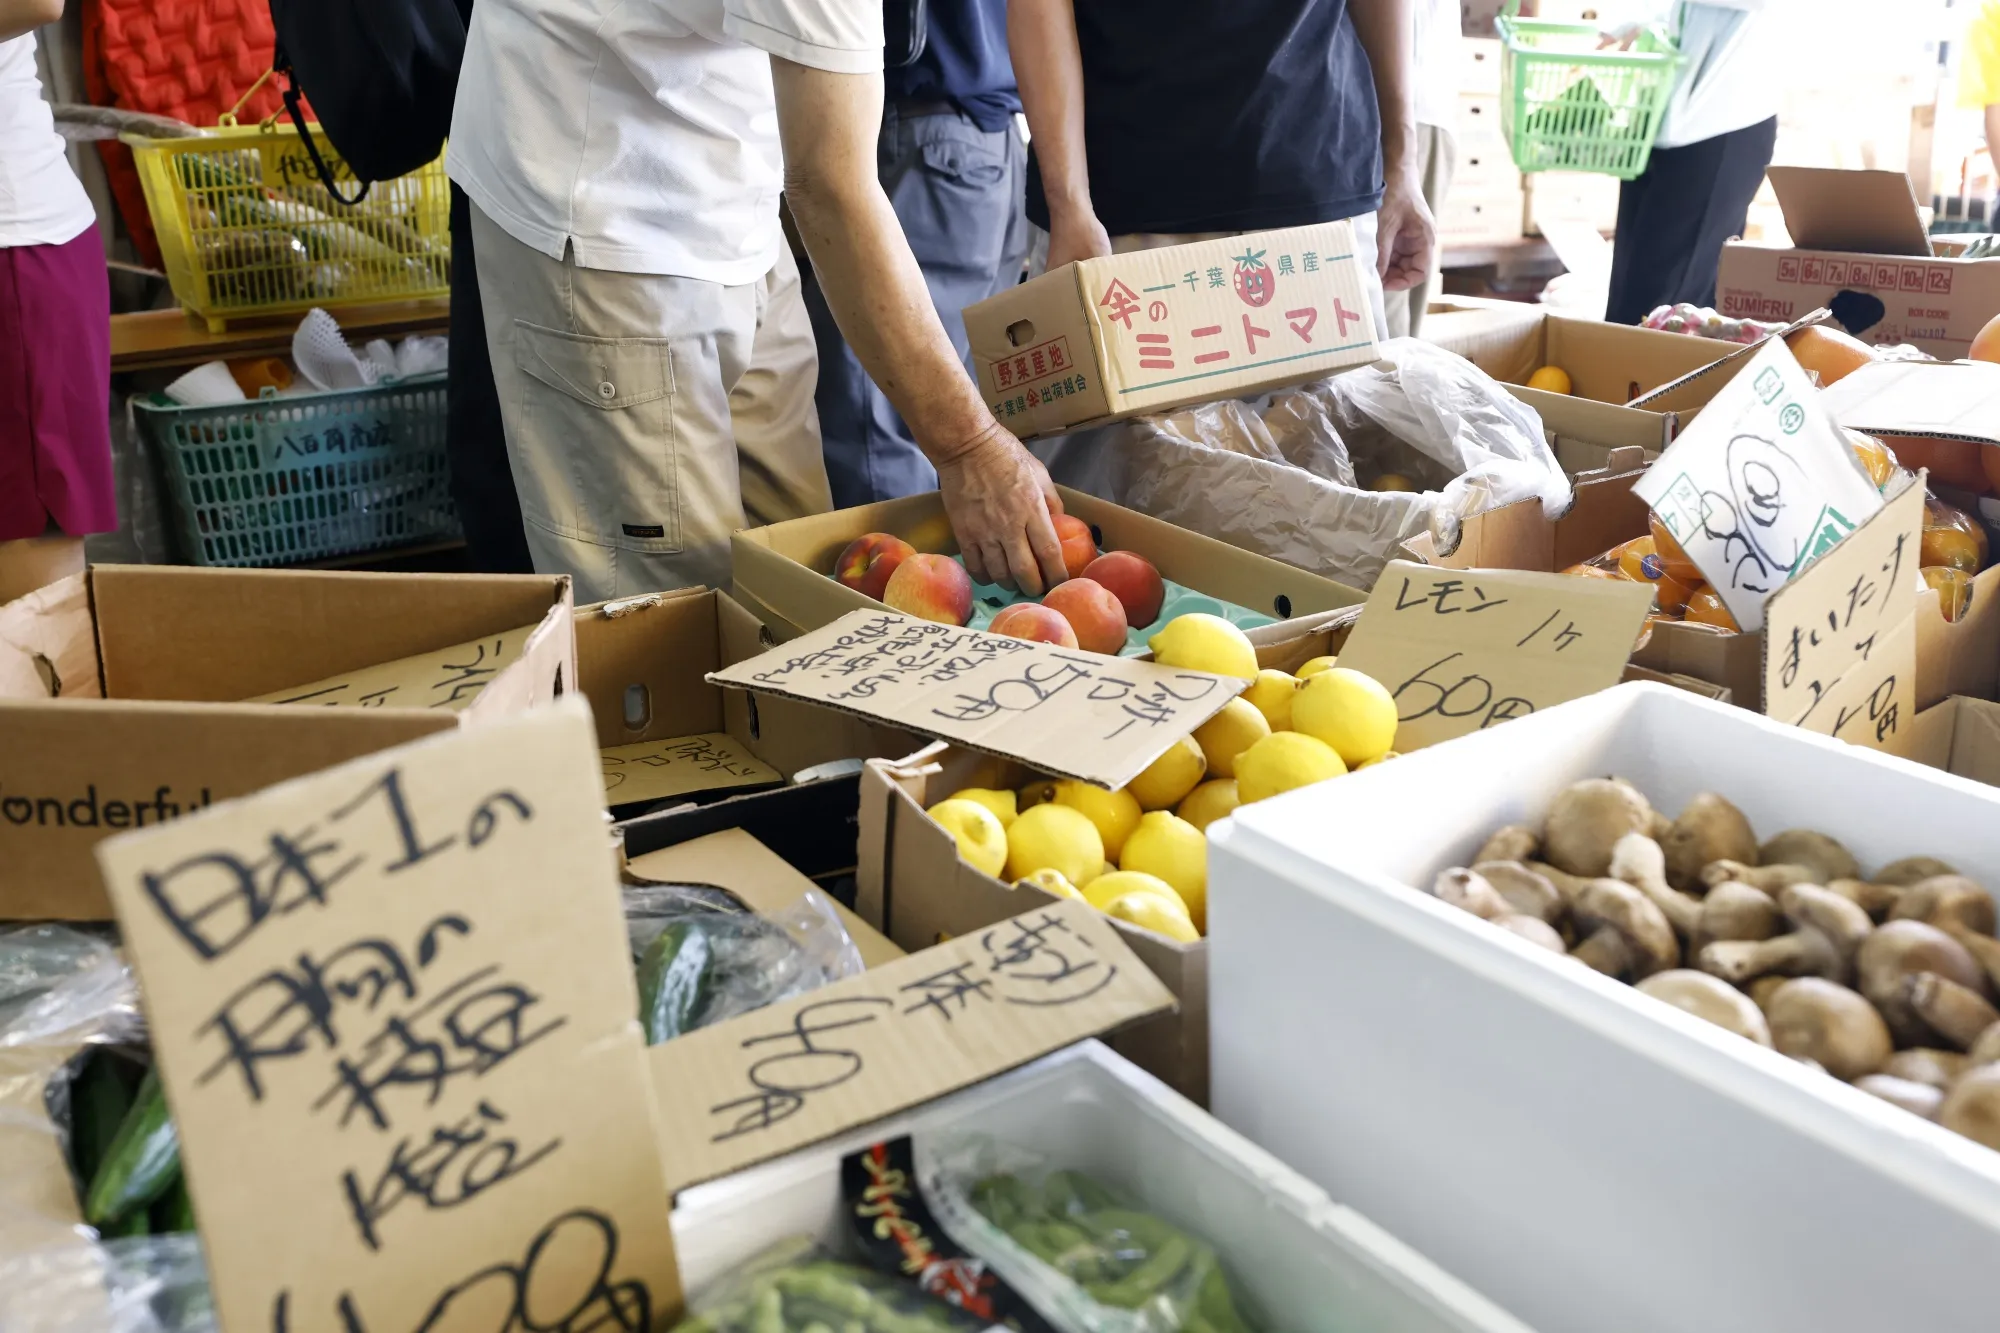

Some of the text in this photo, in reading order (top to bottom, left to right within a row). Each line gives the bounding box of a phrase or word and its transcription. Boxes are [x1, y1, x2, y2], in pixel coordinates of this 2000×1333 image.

[1182, 251, 1320, 293] 千葉 県産
[1723, 296, 1794, 316] SUMIFRU
[1908, 307, 1924, 317] BOX
[1135, 298, 1360, 370] ミニトマト
[998, 343, 1064, 386] 野菜産地
[1395, 577, 1509, 614] レモン
[0, 783, 212, 828] onderf
